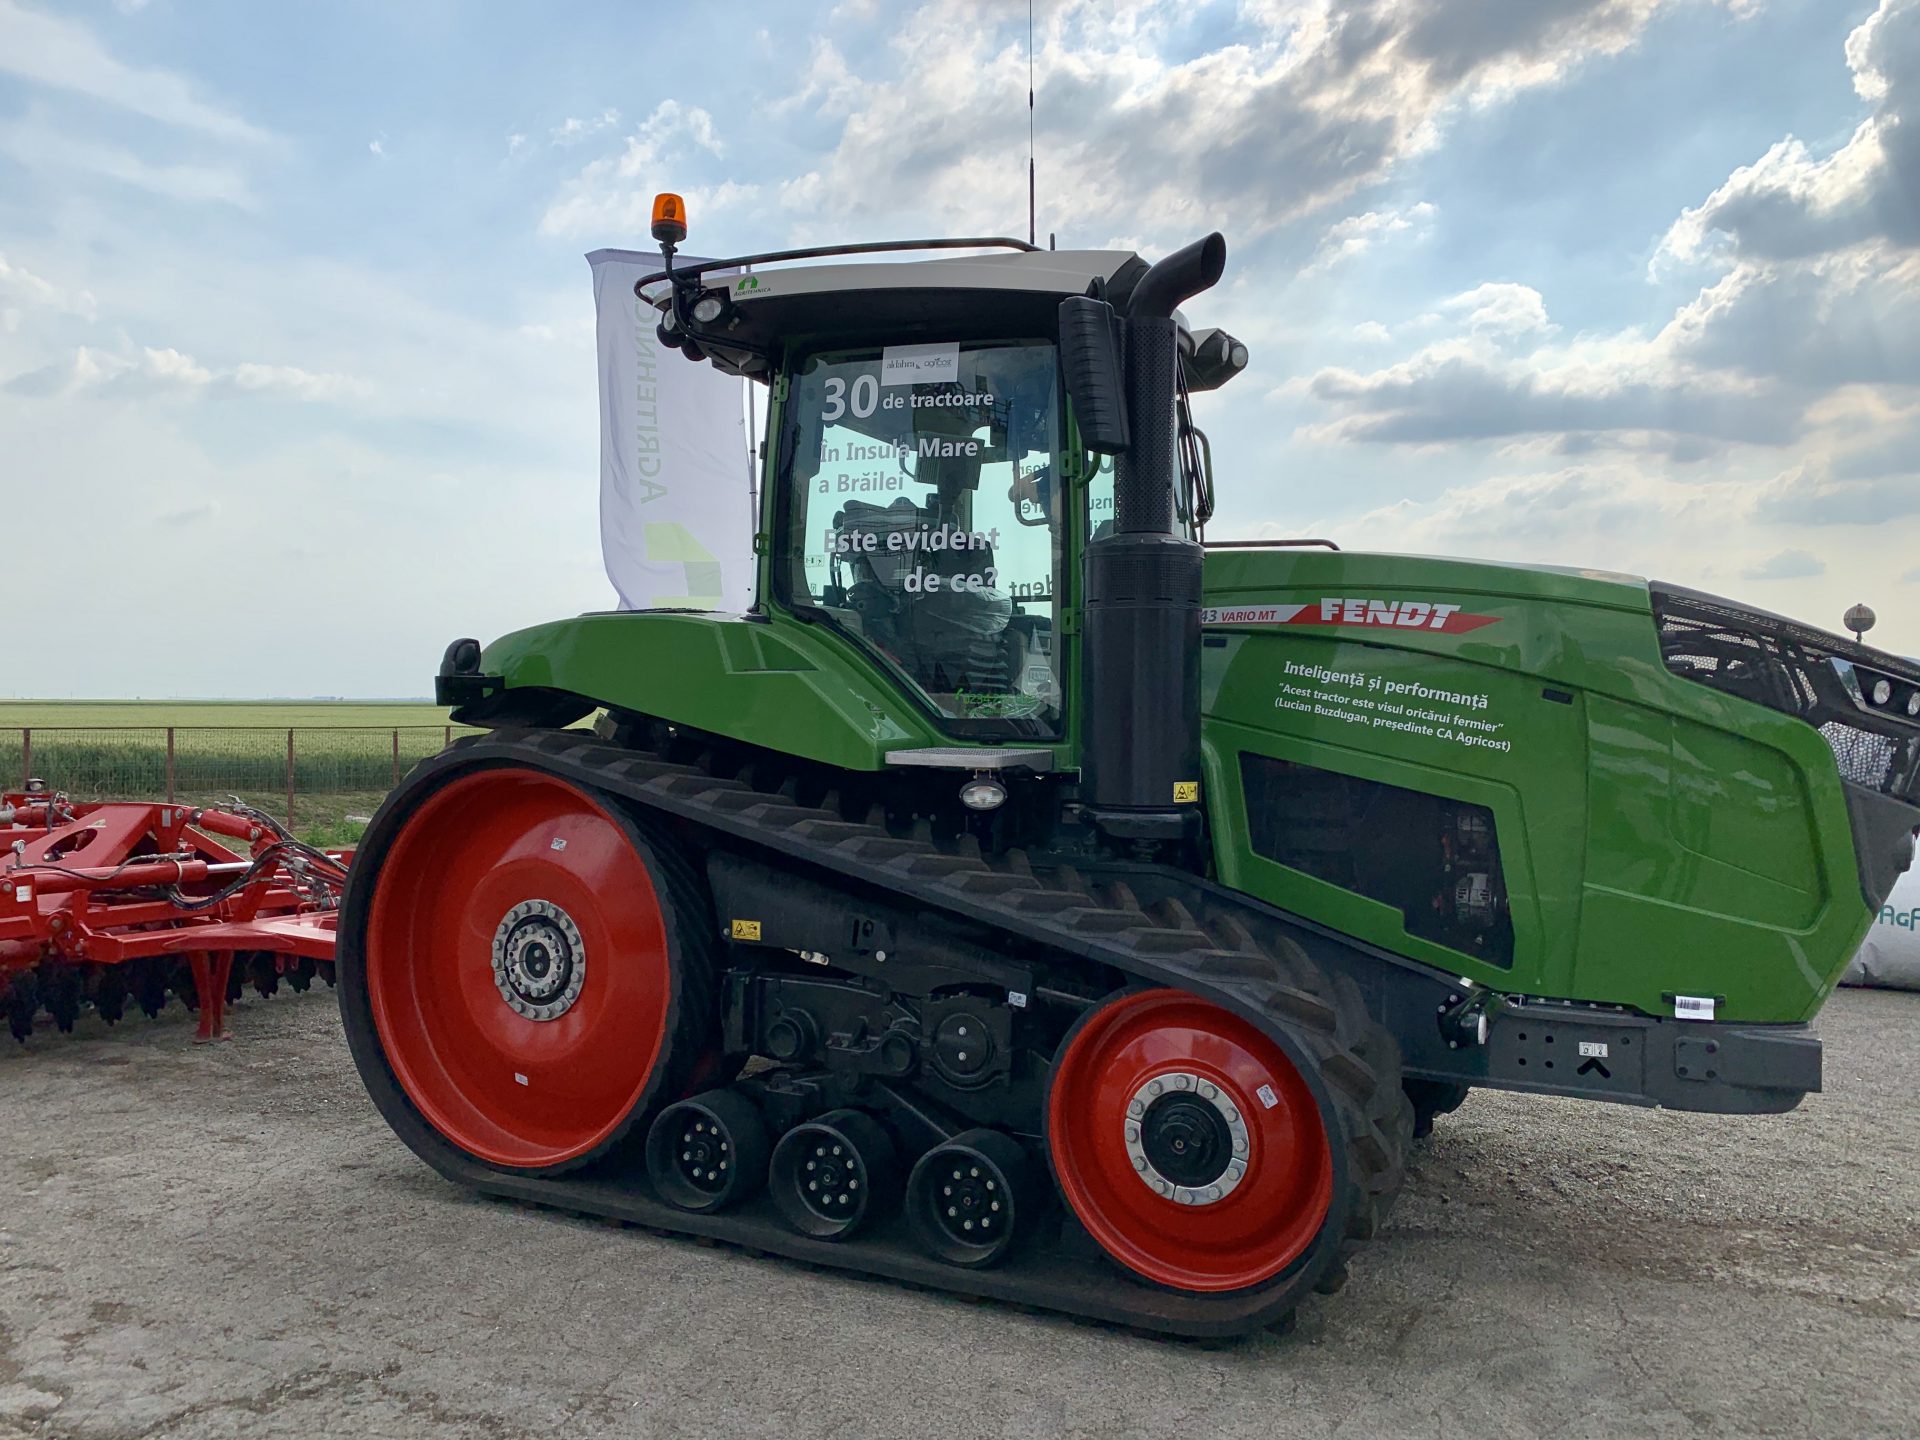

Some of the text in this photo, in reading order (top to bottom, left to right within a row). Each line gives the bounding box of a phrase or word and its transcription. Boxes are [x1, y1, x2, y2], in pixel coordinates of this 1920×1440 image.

[822, 374, 994, 421] 30 de tractoare
[820, 438, 978, 462] În Insula Mare
[818, 471, 904, 493] a Brăilei
[824, 523, 1000, 553] Este evident
[904, 566, 999, 593] de ce?
[1200, 609, 1277, 622] 43 VARIO MT
[1320, 597, 1461, 629] FENDT
[1284, 661, 1489, 711] Inteligență și performanță
[1314, 690, 1350, 704] tractor
[1352, 698, 1375, 709] este
[1377, 702, 1403, 715] visul
[1406, 708, 1451, 723] oricărui
[1275, 697, 1311, 712] (Lucian
[1314, 704, 1370, 725] Buzdugan,
[1437, 728, 1453, 740] CA
[1456, 732, 1511, 752] Agricost)
